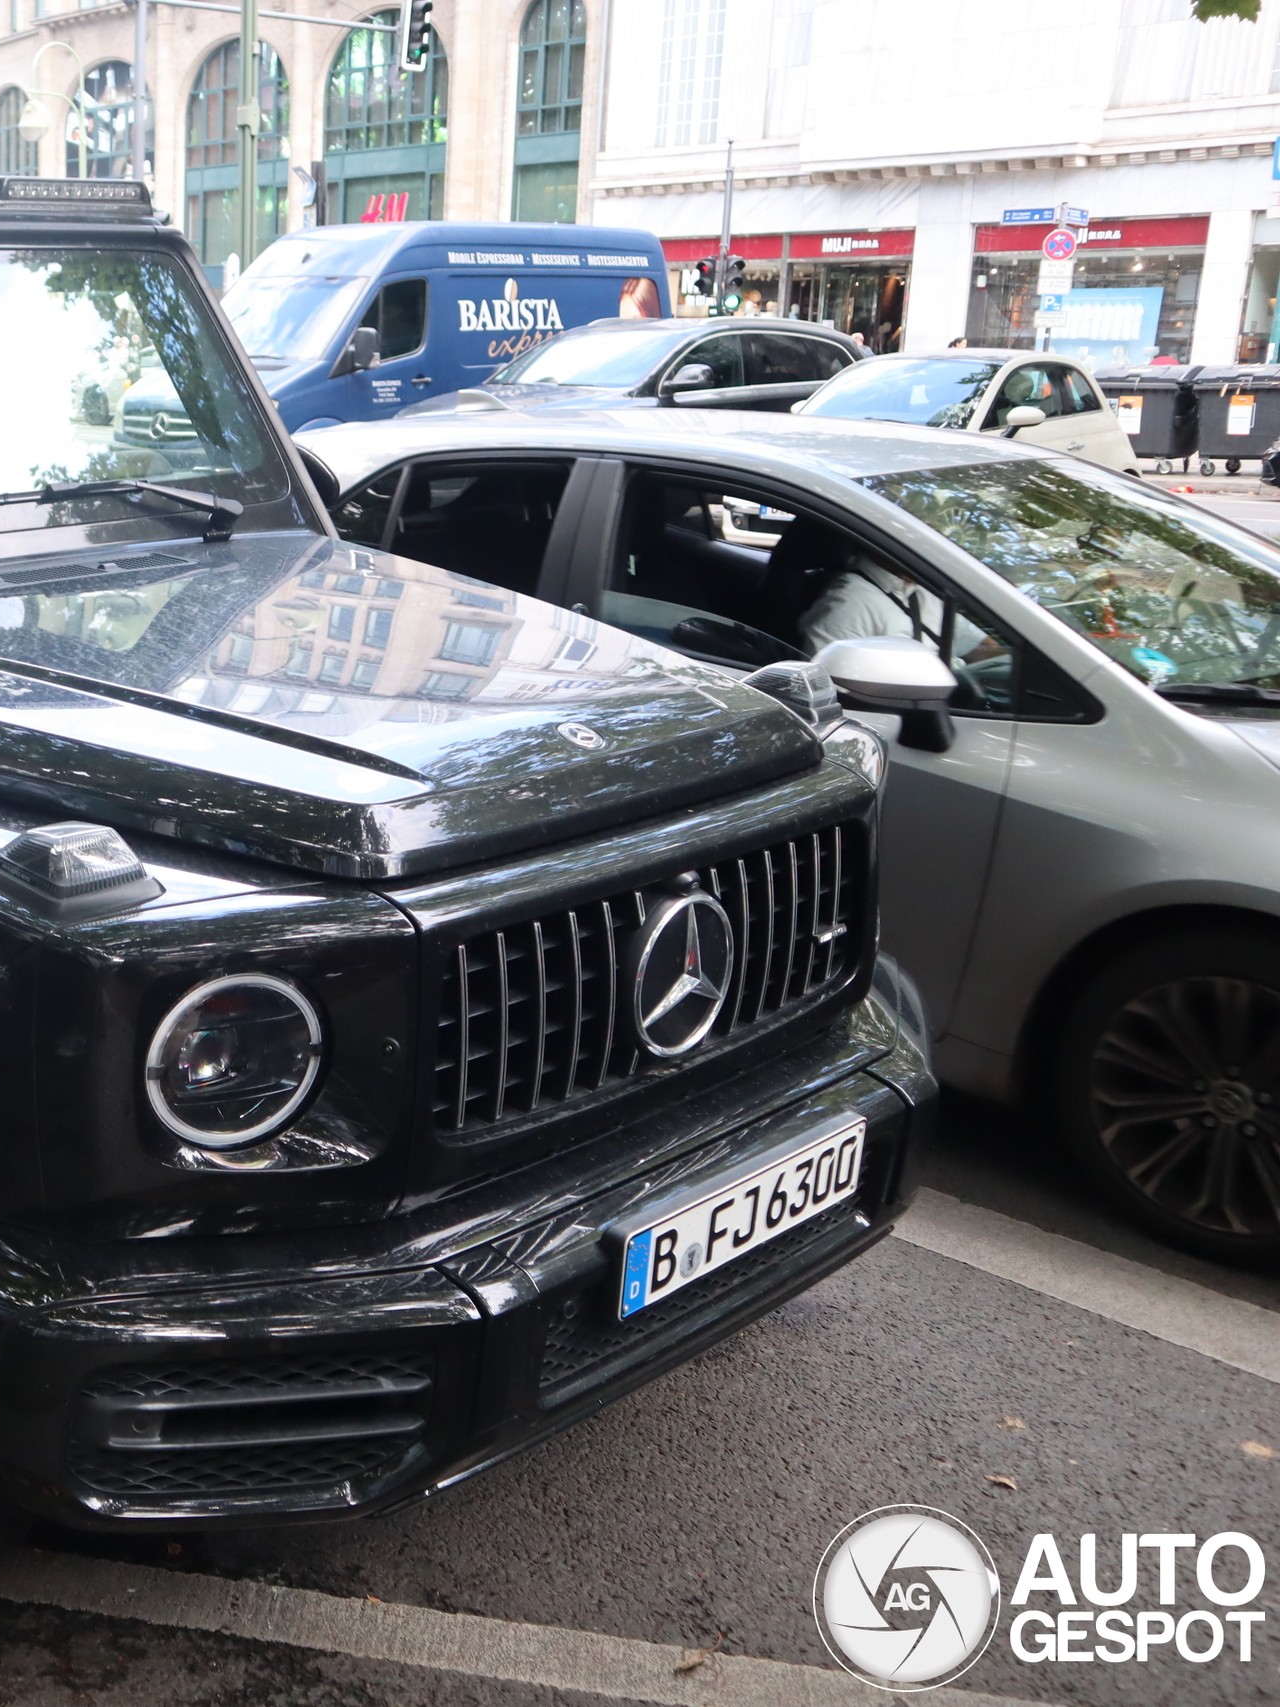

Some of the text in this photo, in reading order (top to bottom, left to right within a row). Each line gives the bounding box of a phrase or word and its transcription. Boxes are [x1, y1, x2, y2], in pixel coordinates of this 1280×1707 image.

[821, 237, 852, 253] MUJI
[458, 299, 564, 331] BARISTA
[650, 1228, 679, 1294] B
[630, 1281, 640, 1299] D
